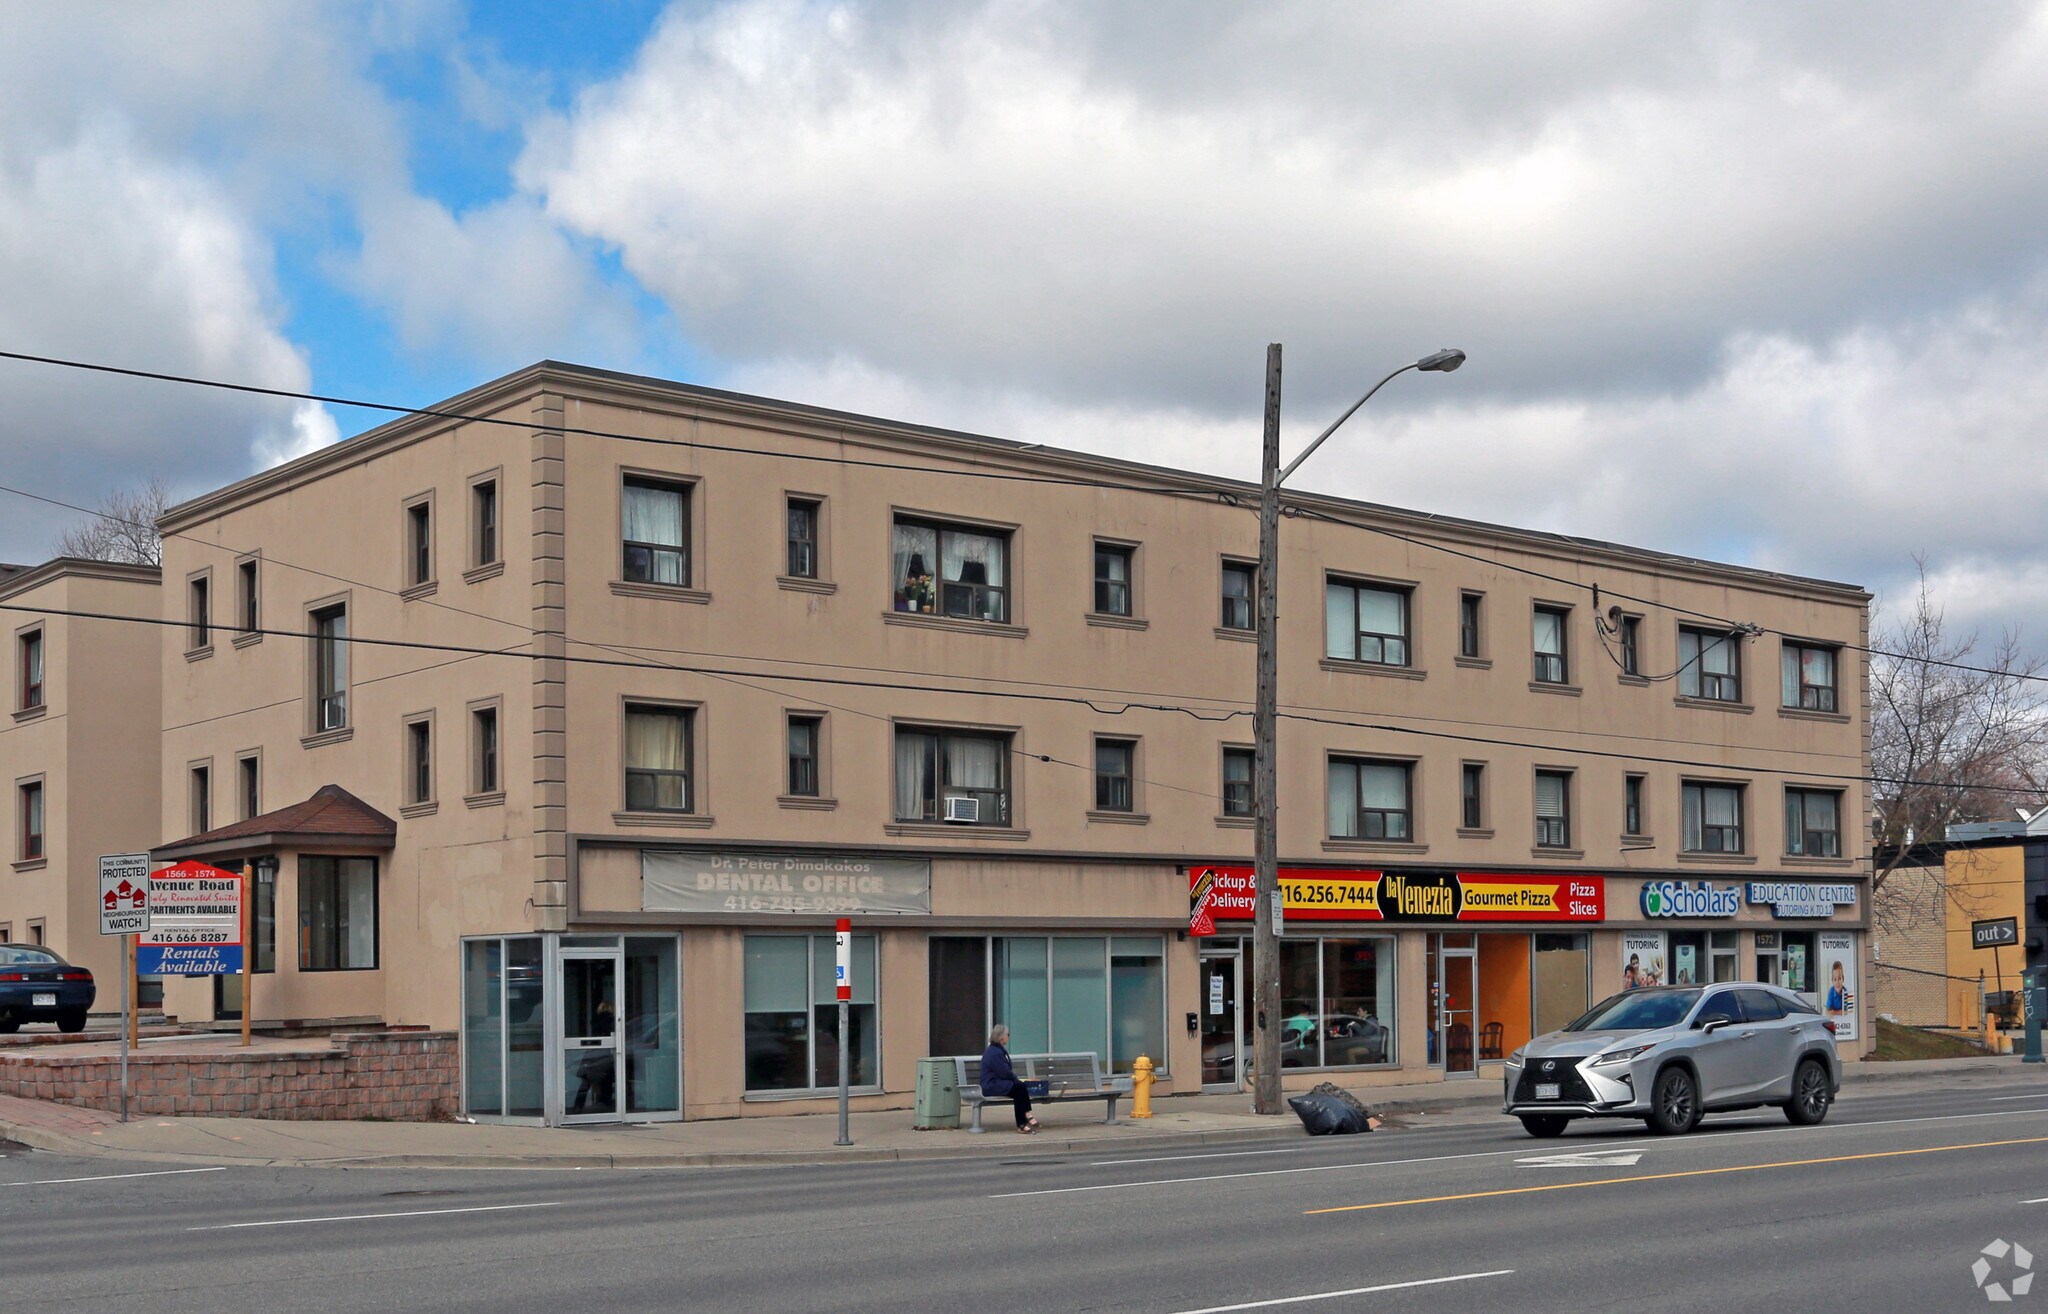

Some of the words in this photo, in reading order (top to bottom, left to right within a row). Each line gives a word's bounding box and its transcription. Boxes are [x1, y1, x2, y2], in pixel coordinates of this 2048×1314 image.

[711, 857, 733, 868] Dr.
[739, 858, 779, 870] Peter
[785, 858, 870, 872] Dimakakos
[102, 867, 146, 878] PROTECTED
[199, 880, 234, 891] Road
[697, 873, 794, 892] DENTAL
[802, 875, 884, 893] OFFICE
[1213, 873, 1246, 892] ickup
[1248, 874, 1256, 889] &
[1387, 876, 1397, 898] Da
[1396, 876, 1453, 915] Venezia
[1570, 882, 1595, 897] Pizza
[1753, 885, 1815, 901] EDUCATION
[1819, 886, 1855, 902] CENTRE
[171, 893, 211, 902] Renovated
[214, 893, 238, 902] Suites
[1465, 889, 1518, 906] Gourmet
[1521, 890, 1551, 906] Pizza
[1662, 884, 1737, 914] Scholars
[197, 905, 237, 914] AVAILABLE
[1569, 901, 1597, 915] Slices
[1778, 904, 1808, 914] TUTORING
[1810, 904, 1815, 914] K
[1816, 904, 1823, 914] TO
[1825, 904, 1833, 915] 12
[109, 918, 142, 929] WATCH
[152, 934, 172, 942] 416
[176, 934, 197, 942] 666
[200, 934, 228, 942] 8287
[1756, 934, 1774, 944] 1572
[1977, 926, 1999, 942] out
[1626, 940, 1659, 949] TUTORING
[1822, 940, 1850, 949] TUTORING
[161, 947, 220, 959] Rentals
[154, 960, 227, 973] Available
